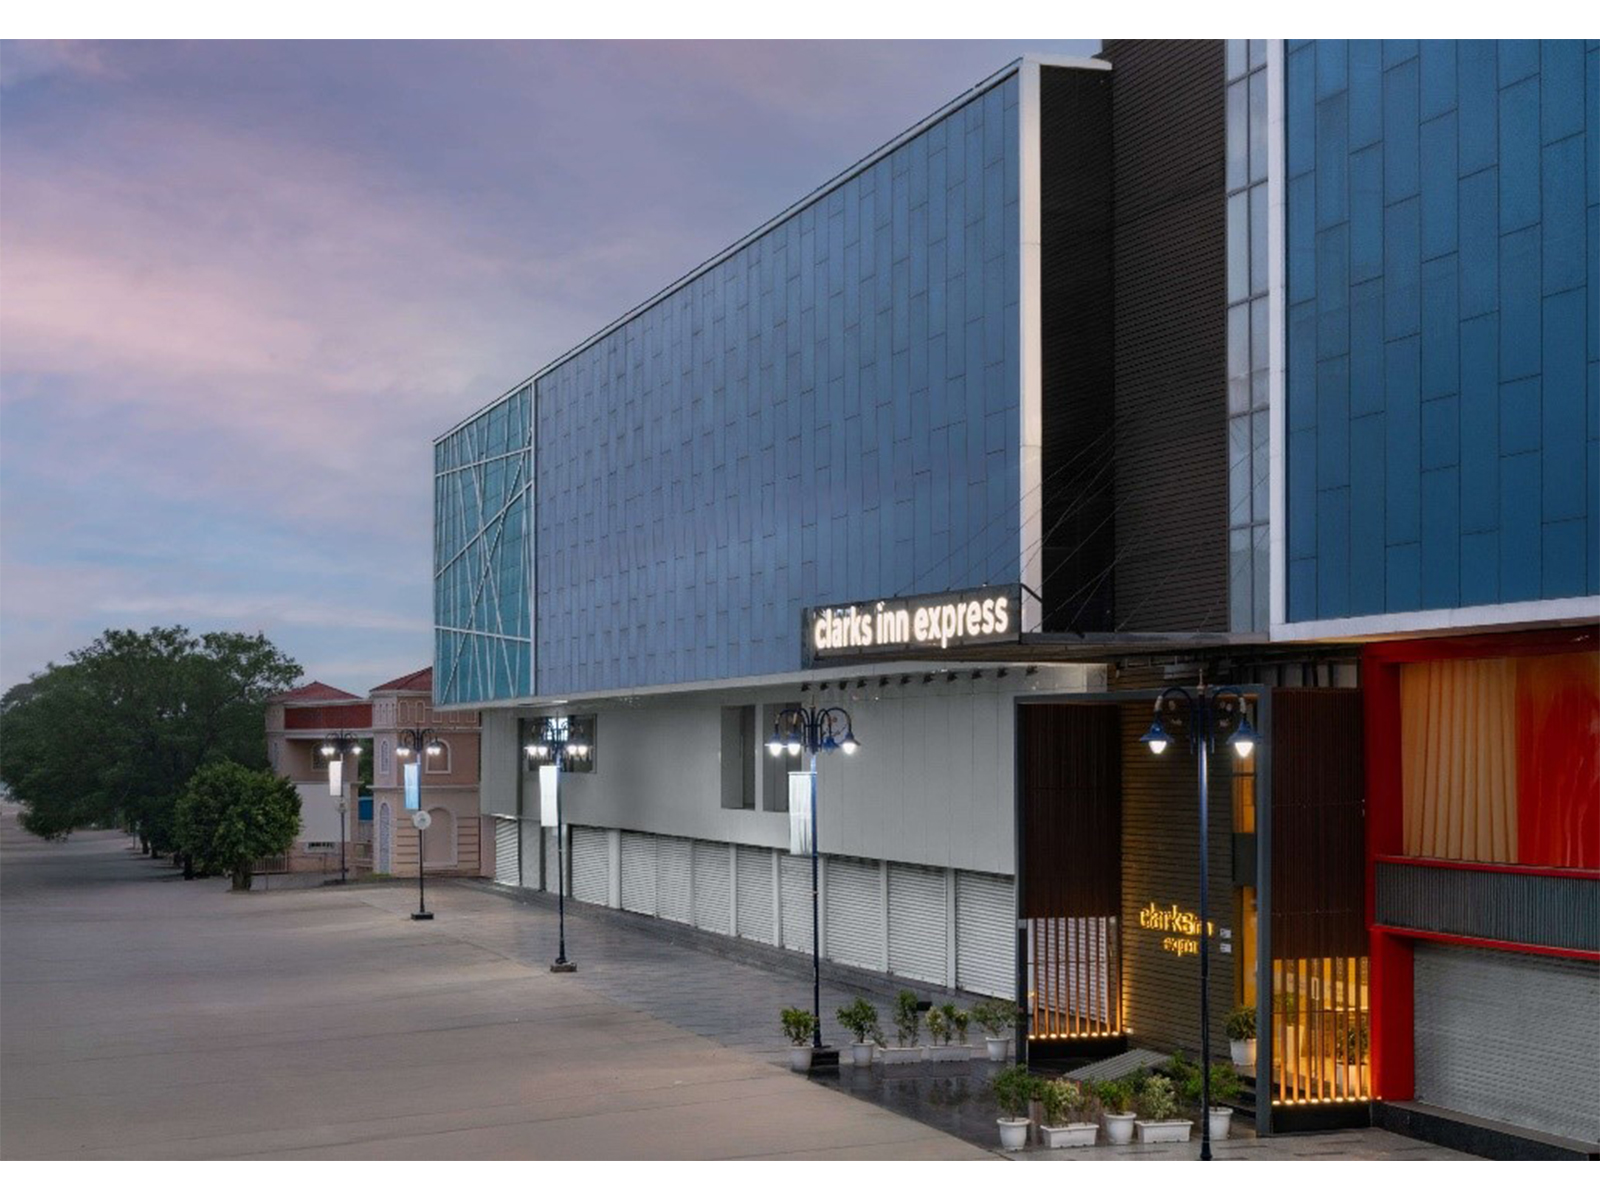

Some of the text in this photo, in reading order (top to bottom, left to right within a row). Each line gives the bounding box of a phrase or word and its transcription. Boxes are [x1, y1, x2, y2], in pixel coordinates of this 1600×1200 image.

[814, 597, 1009, 649] clarks inn express
